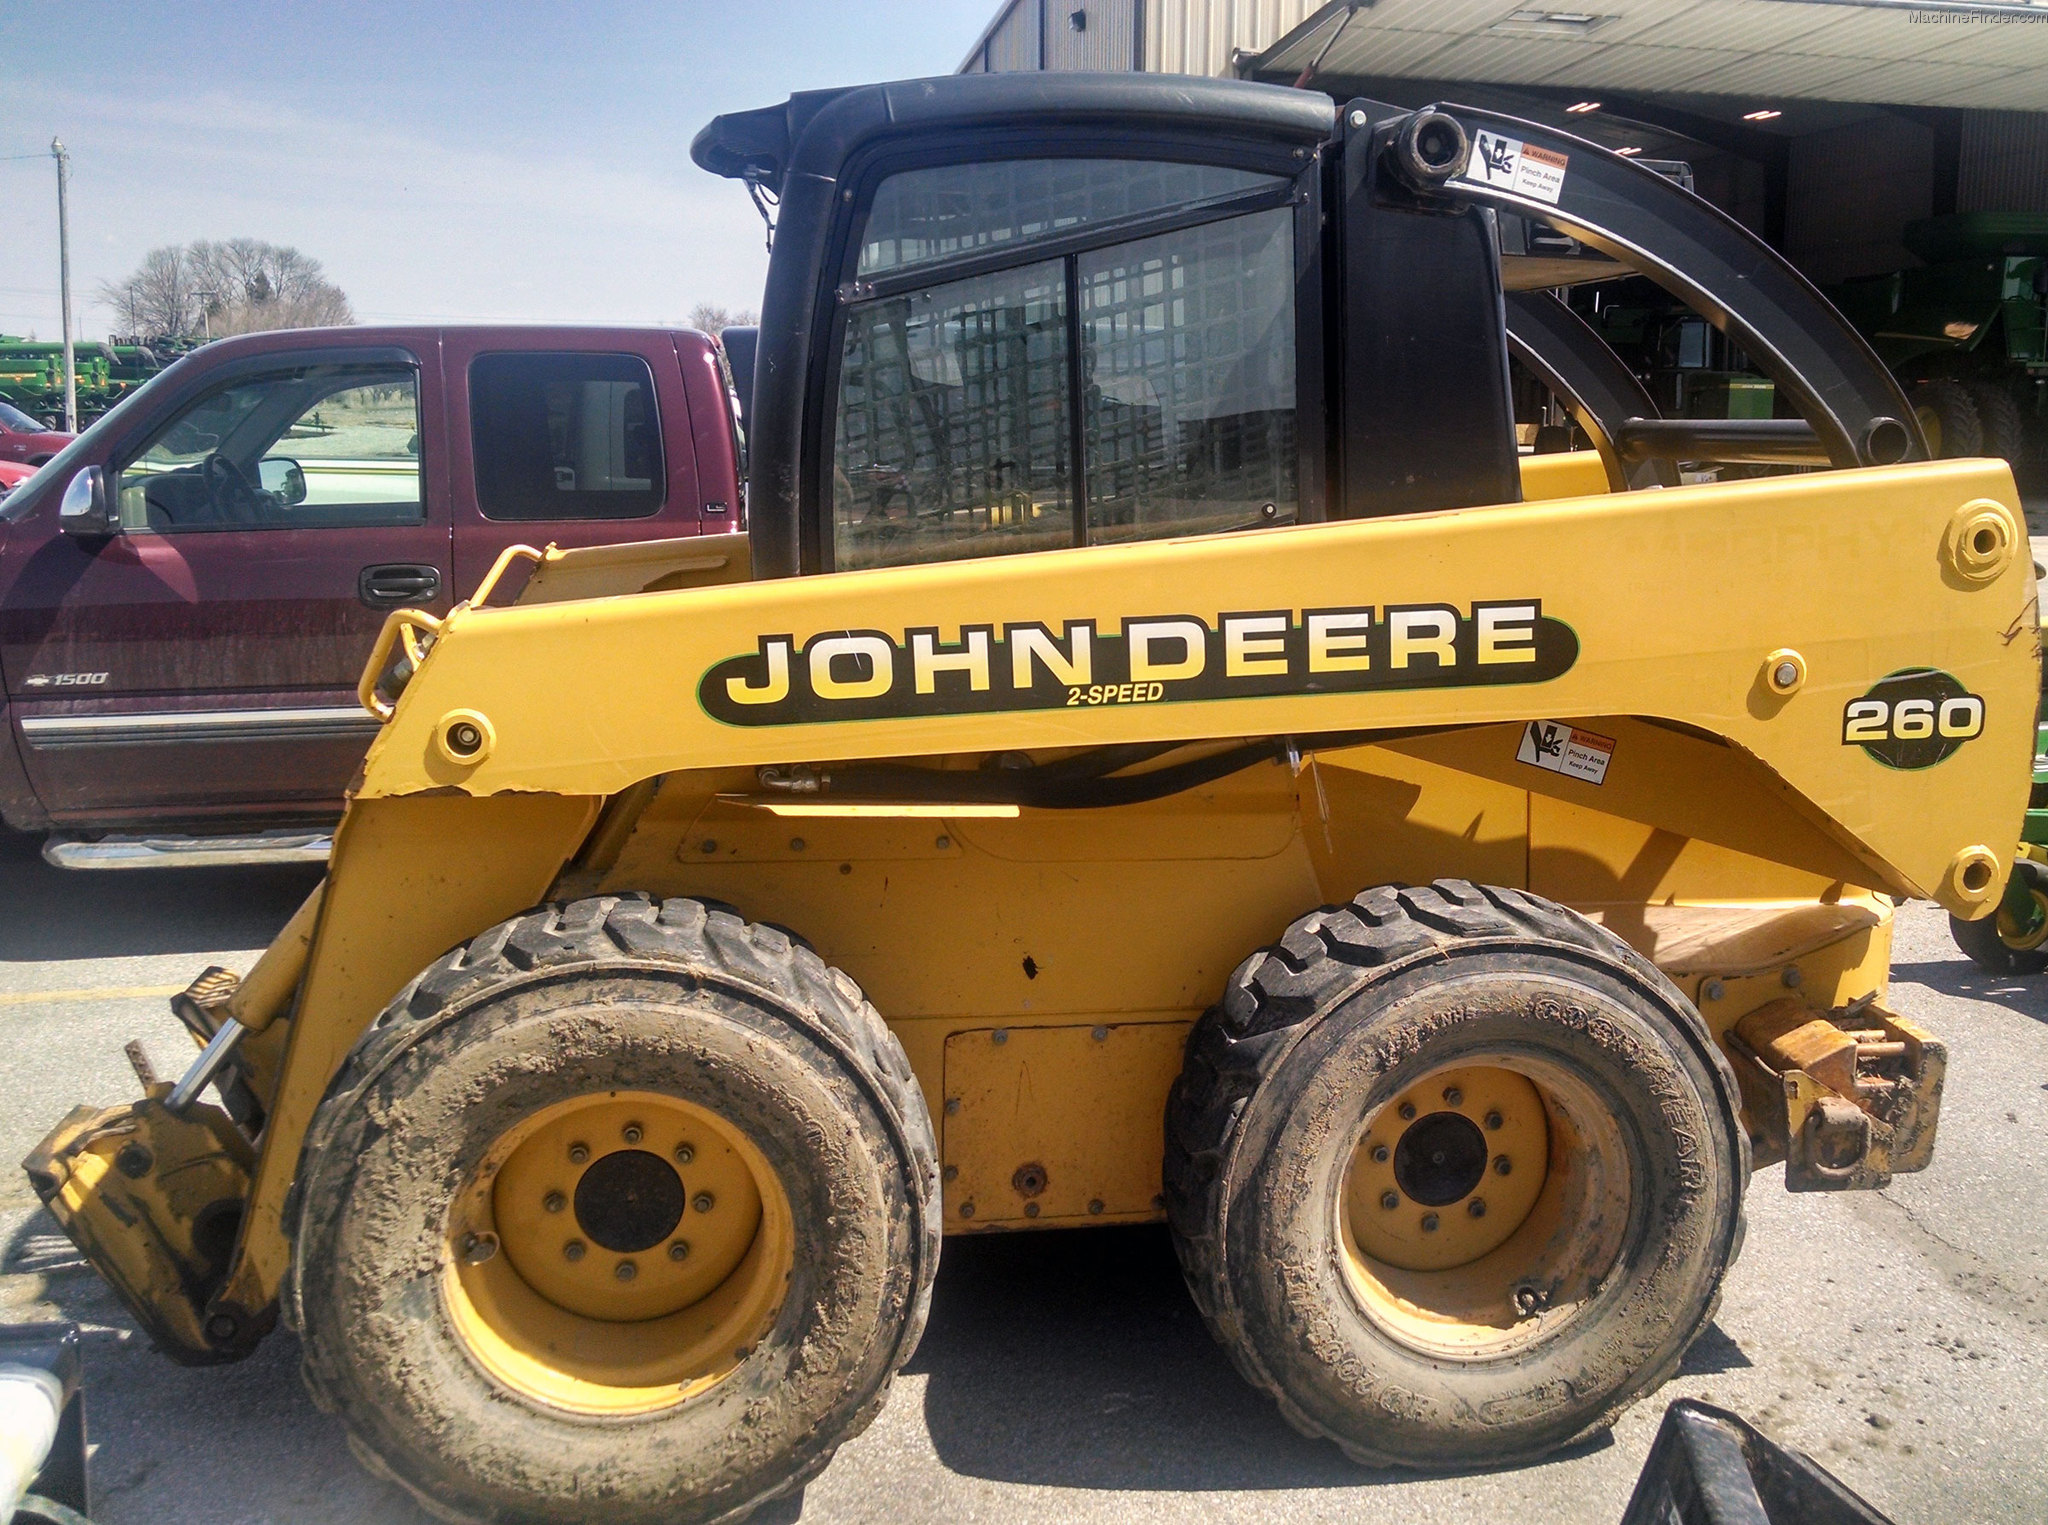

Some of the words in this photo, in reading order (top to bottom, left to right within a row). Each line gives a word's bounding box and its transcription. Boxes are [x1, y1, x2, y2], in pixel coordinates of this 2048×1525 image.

[1532, 150, 1565, 166] WARNING
[1521, 165, 1541, 178] Pinch
[1542, 172, 1561, 184] Area
[1522, 179, 1537, 189] Keep
[726, 625, 1092, 705] JOHN
[1128, 605, 1536, 682] DEERE
[54, 672, 109, 686] 1500
[1066, 682, 1164, 706] 2-SPEED
[1846, 698, 1983, 741] 260
[1580, 735, 1612, 750] WARNING
[1568, 749, 1588, 760] Pinch
[1588, 755, 1605, 766] Area
[1569, 761, 1583, 770] Keep
[1583, 765, 1598, 775] Away
